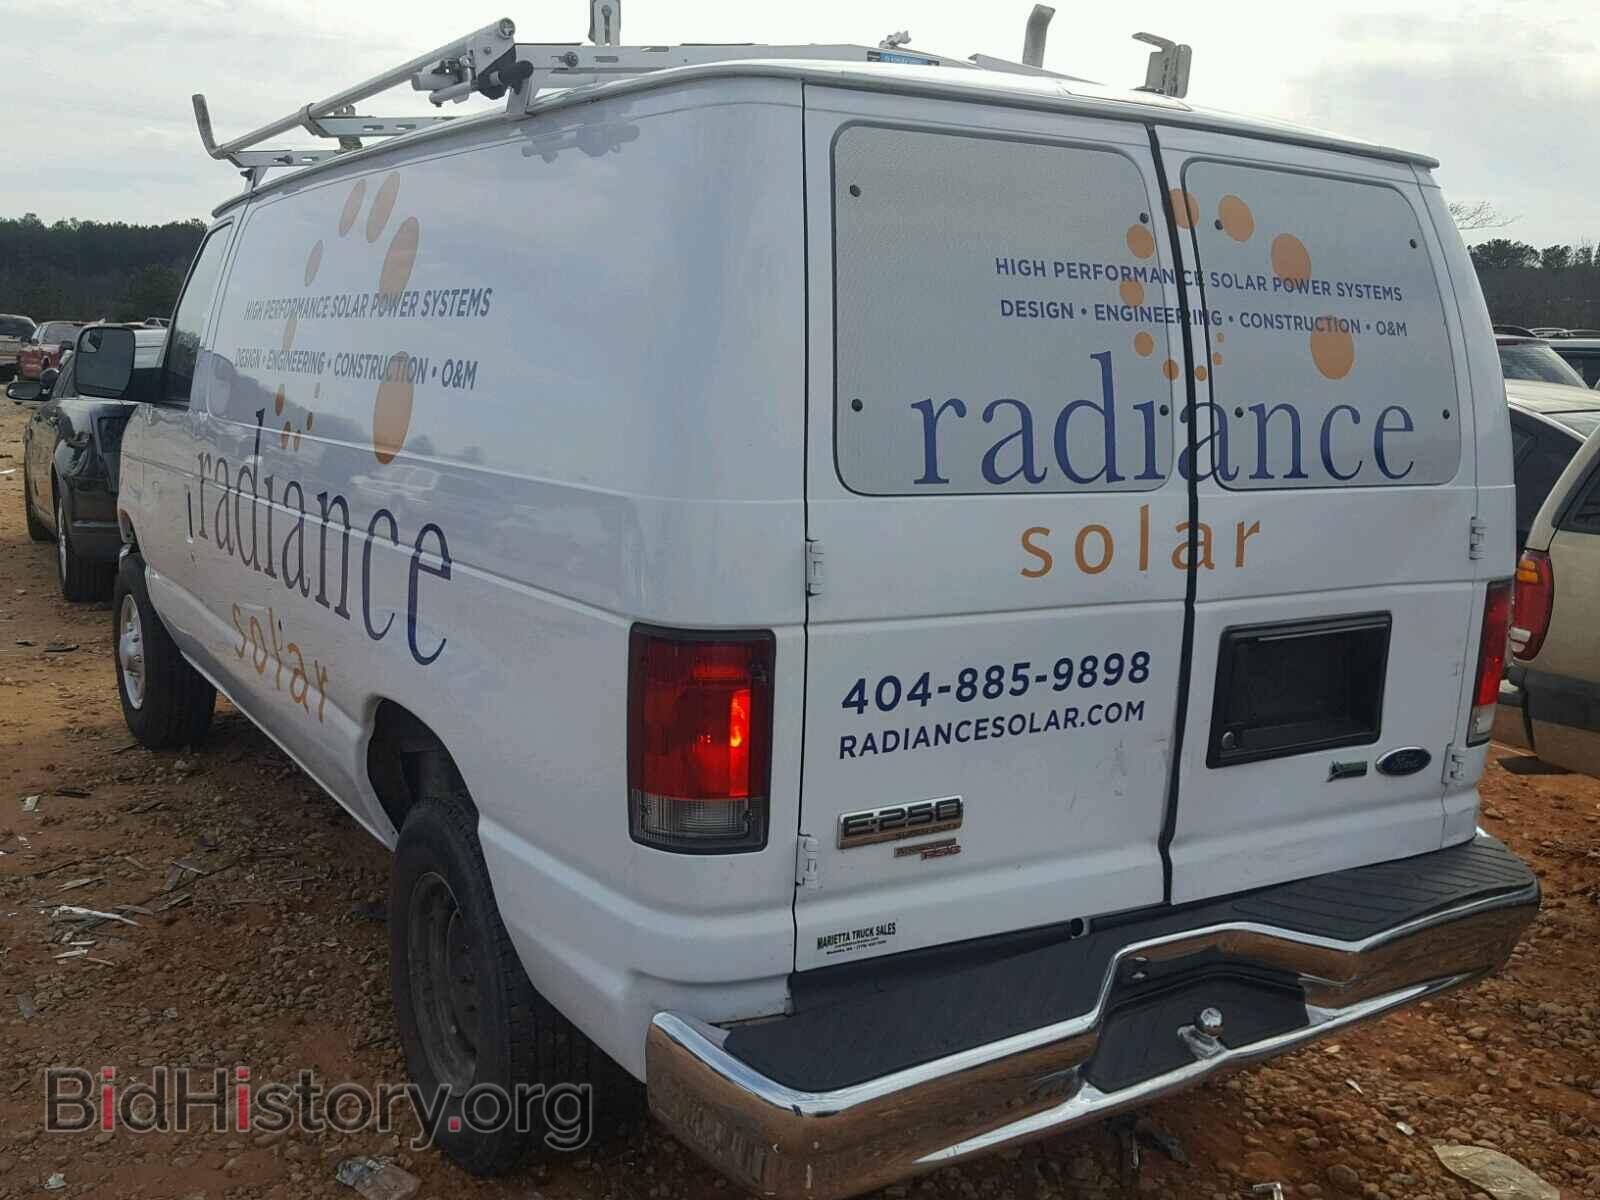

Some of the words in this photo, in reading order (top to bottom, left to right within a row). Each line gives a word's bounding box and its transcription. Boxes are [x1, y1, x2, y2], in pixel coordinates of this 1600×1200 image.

[243, 298, 264, 320] HIGH
[264, 295, 331, 320] PERFORMANCE
[331, 293, 367, 319] SOLAR
[370, 290, 416, 318] POWER
[421, 287, 493, 317] SYSTEMS
[996, 257, 1046, 278] HIGH
[1053, 261, 1205, 287] PERFORMANCE
[1210, 271, 1268, 291] SOLAR
[1273, 277, 1331, 297] POWER
[1336, 282, 1402, 301] SYSTEMS
[1000, 299, 1074, 319] DESIGN
[1094, 303, 1223, 326] ENGINEERING
[1239, 312, 1361, 334] CONSTRUCTION
[1376, 320, 1408, 336] O&M
[334, 352, 428, 385] CONSTRUCTION
[441, 359, 479, 390] O&M
[910, 350, 1415, 485] radiance
[199, 408, 451, 666] radiance
[1019, 503, 1261, 579] solar
[231, 602, 328, 723] solar
[841, 650, 1151, 715] 404-885-9898
[839, 700, 1145, 760] RADIANCESOLAR.COM
[817, 931, 851, 950] MARIETTA
[852, 927, 874, 941] TRUCK
[876, 922, 896, 936] SALES
